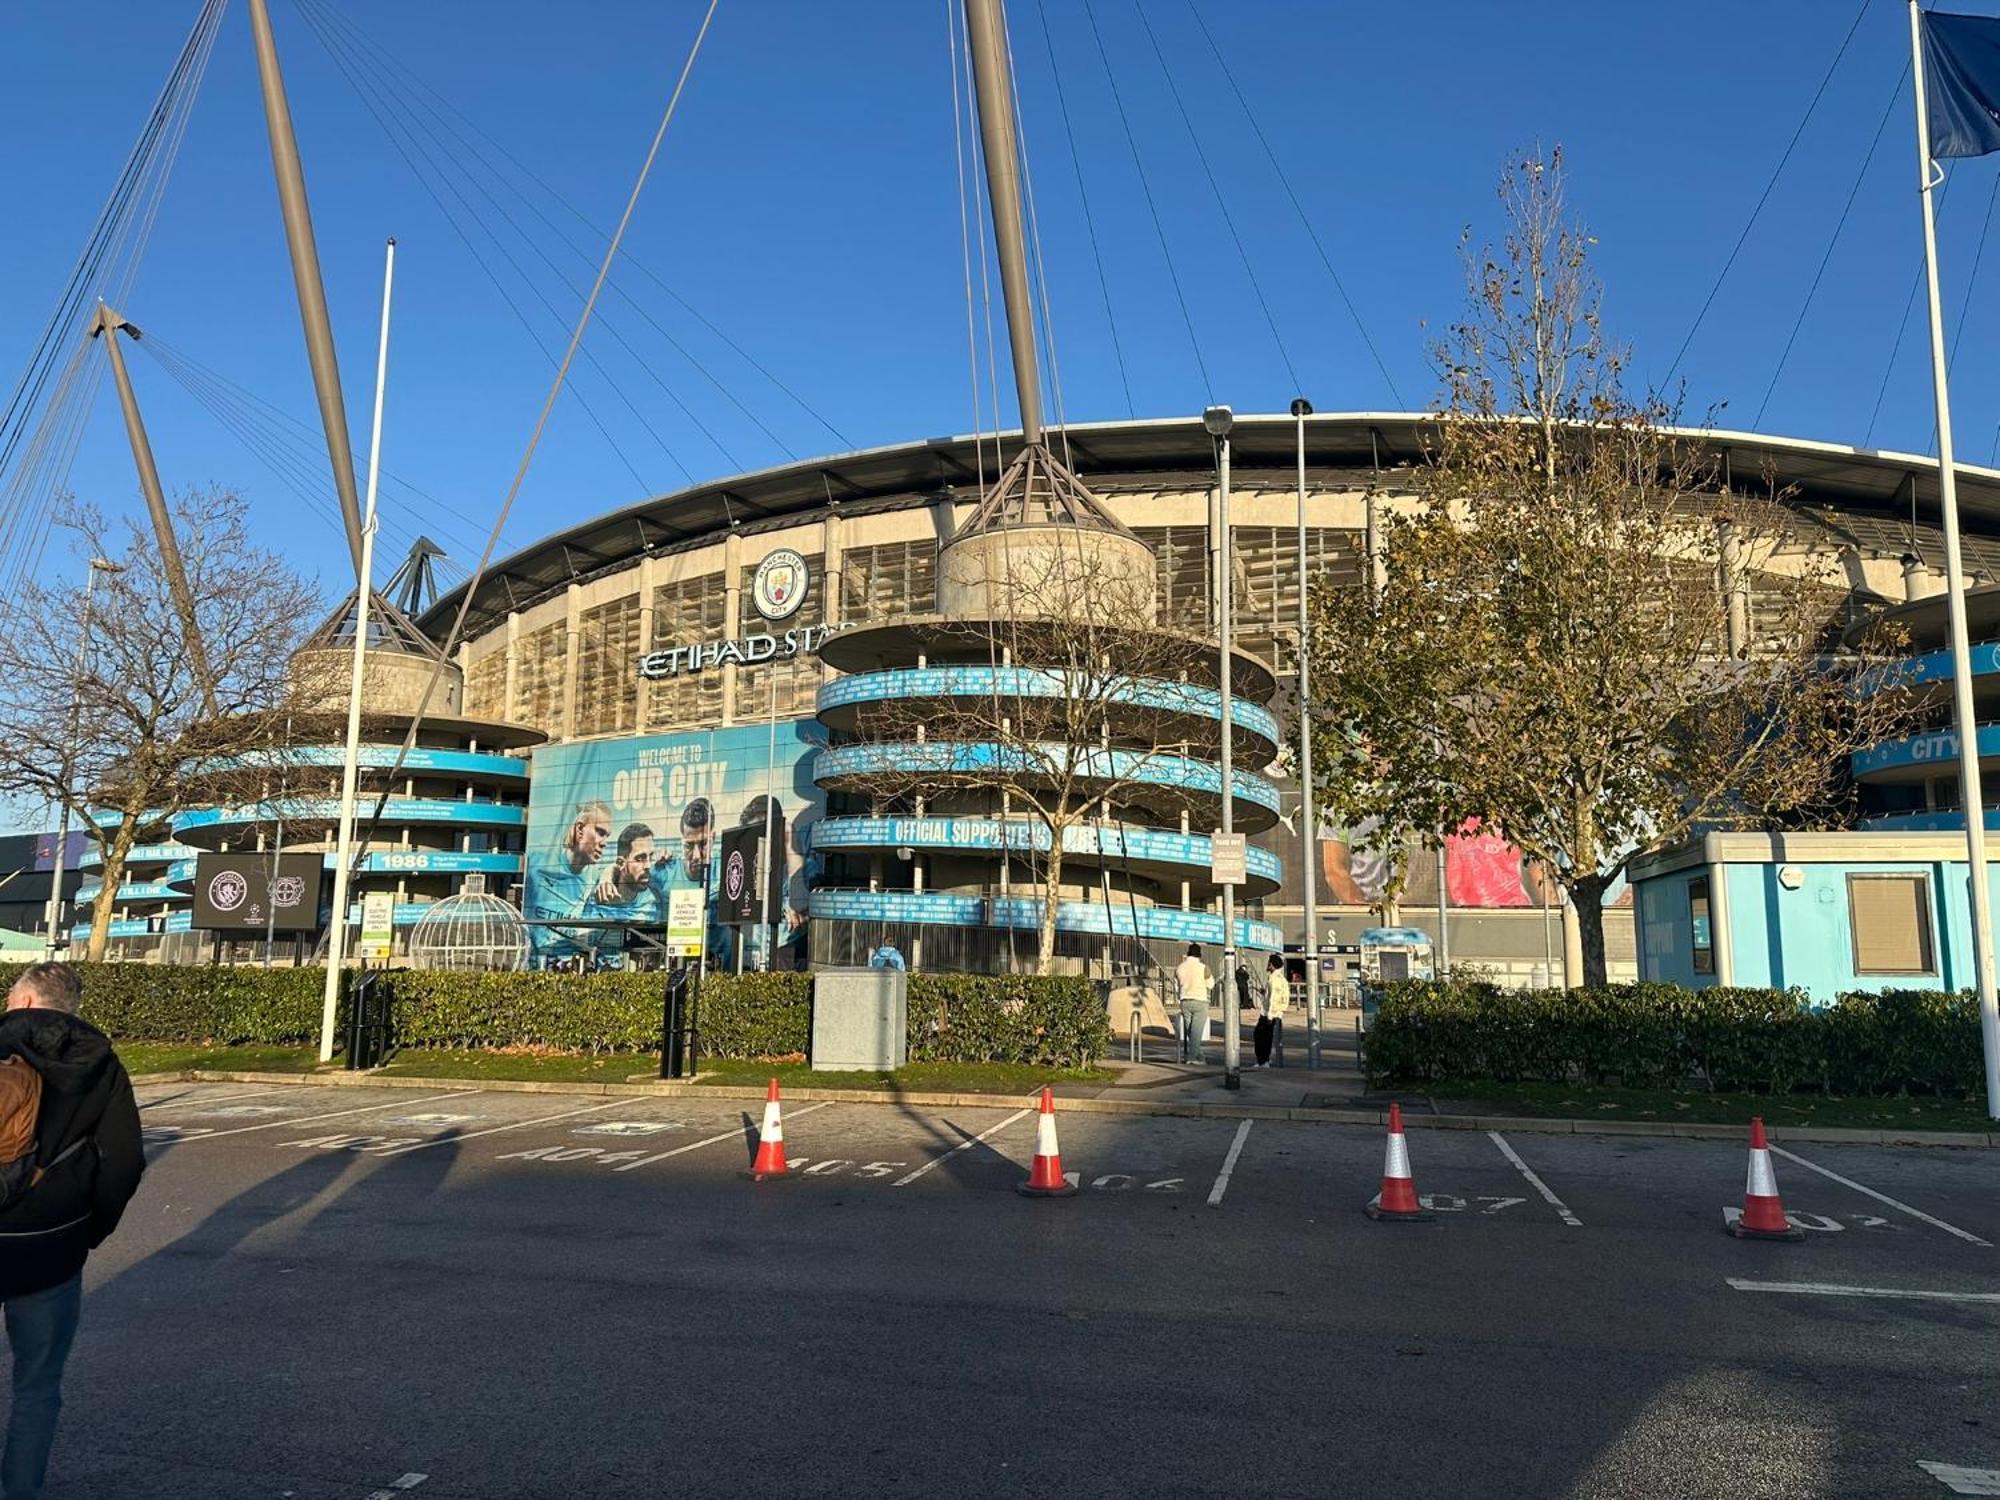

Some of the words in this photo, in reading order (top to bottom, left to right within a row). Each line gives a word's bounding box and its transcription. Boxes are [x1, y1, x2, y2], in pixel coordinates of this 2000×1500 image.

[758, 552, 803, 578] MANCHESTER
[771, 606, 787, 615] CITY
[641, 634, 776, 677] ETIHAD
[639, 746, 688, 767] WELCOME
[690, 744, 702, 763] TO
[1911, 734, 1962, 760] CITY
[613, 766, 664, 811] OUR
[668, 761, 728, 807] CITY
[895, 820, 949, 842] OFFICIAL
[382, 854, 429, 869] 1986
[1327, 929, 1337, 945] S
